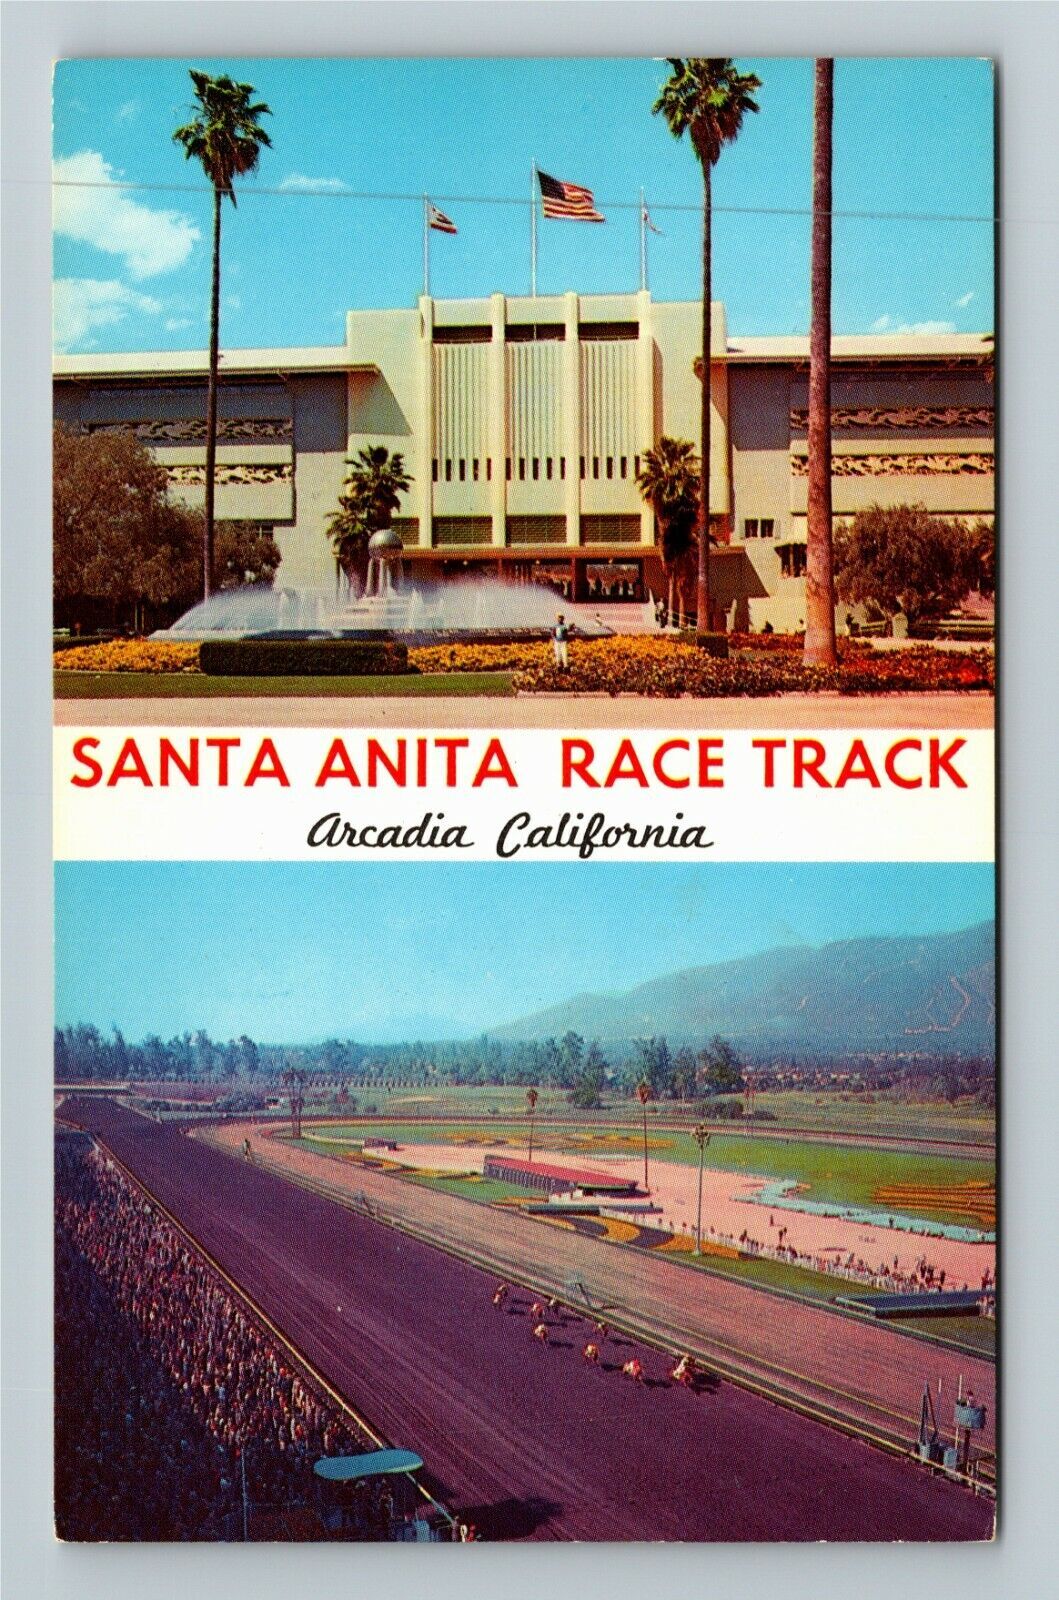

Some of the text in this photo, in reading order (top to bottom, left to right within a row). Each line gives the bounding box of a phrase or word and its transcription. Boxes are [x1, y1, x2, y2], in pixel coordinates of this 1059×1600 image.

[71, 738, 968, 789] SANTA ANITA RACE TRACK
[307, 811, 714, 859] Arcadia California
